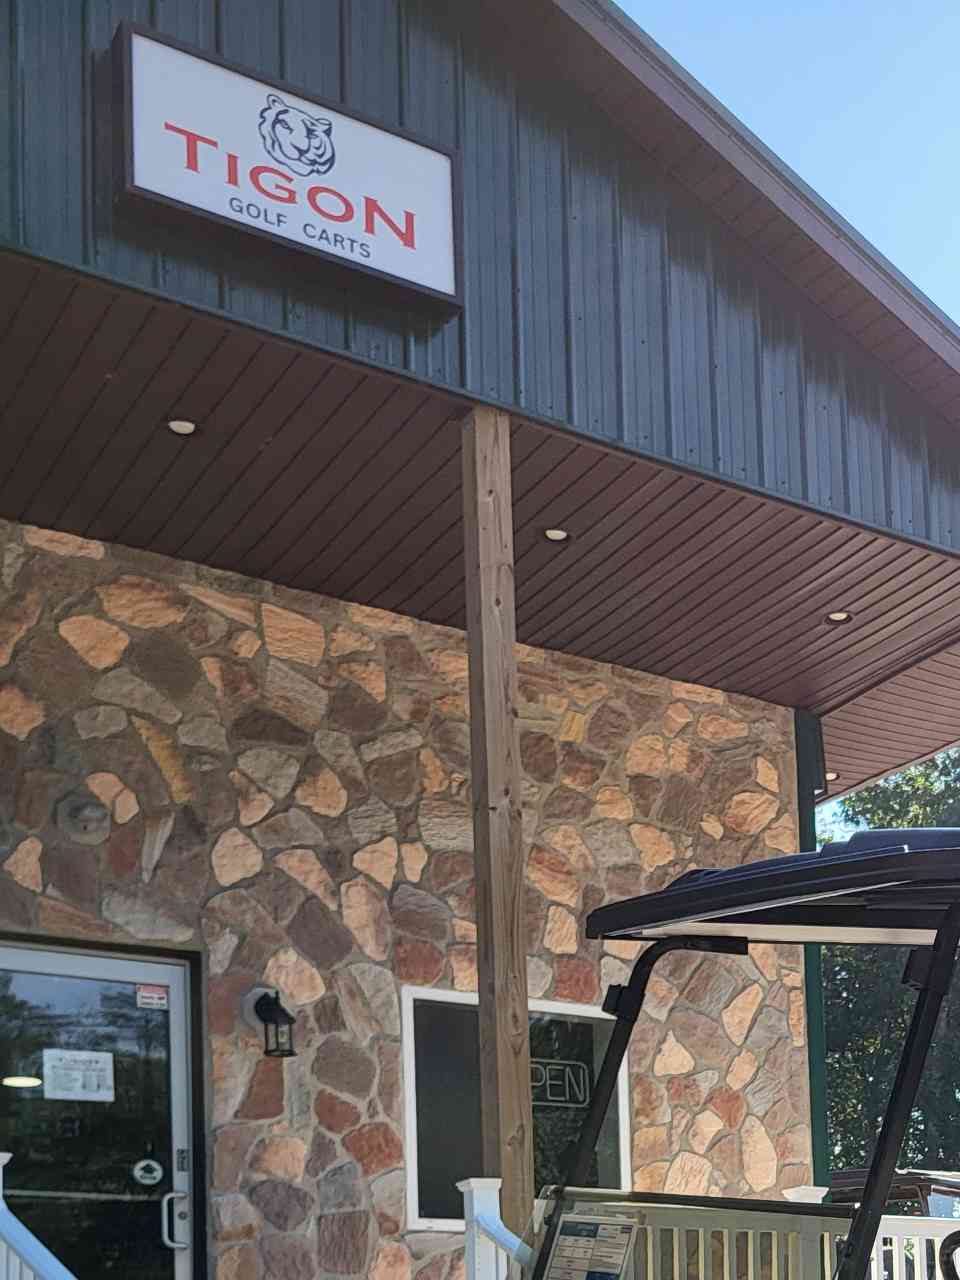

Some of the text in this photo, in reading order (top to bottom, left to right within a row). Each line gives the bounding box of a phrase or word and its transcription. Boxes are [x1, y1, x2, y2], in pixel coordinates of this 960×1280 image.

[164, 121, 416, 249] TIGON
[229, 197, 371, 258] GOLF CARTS
[529, 1064, 585, 1101] PEN
